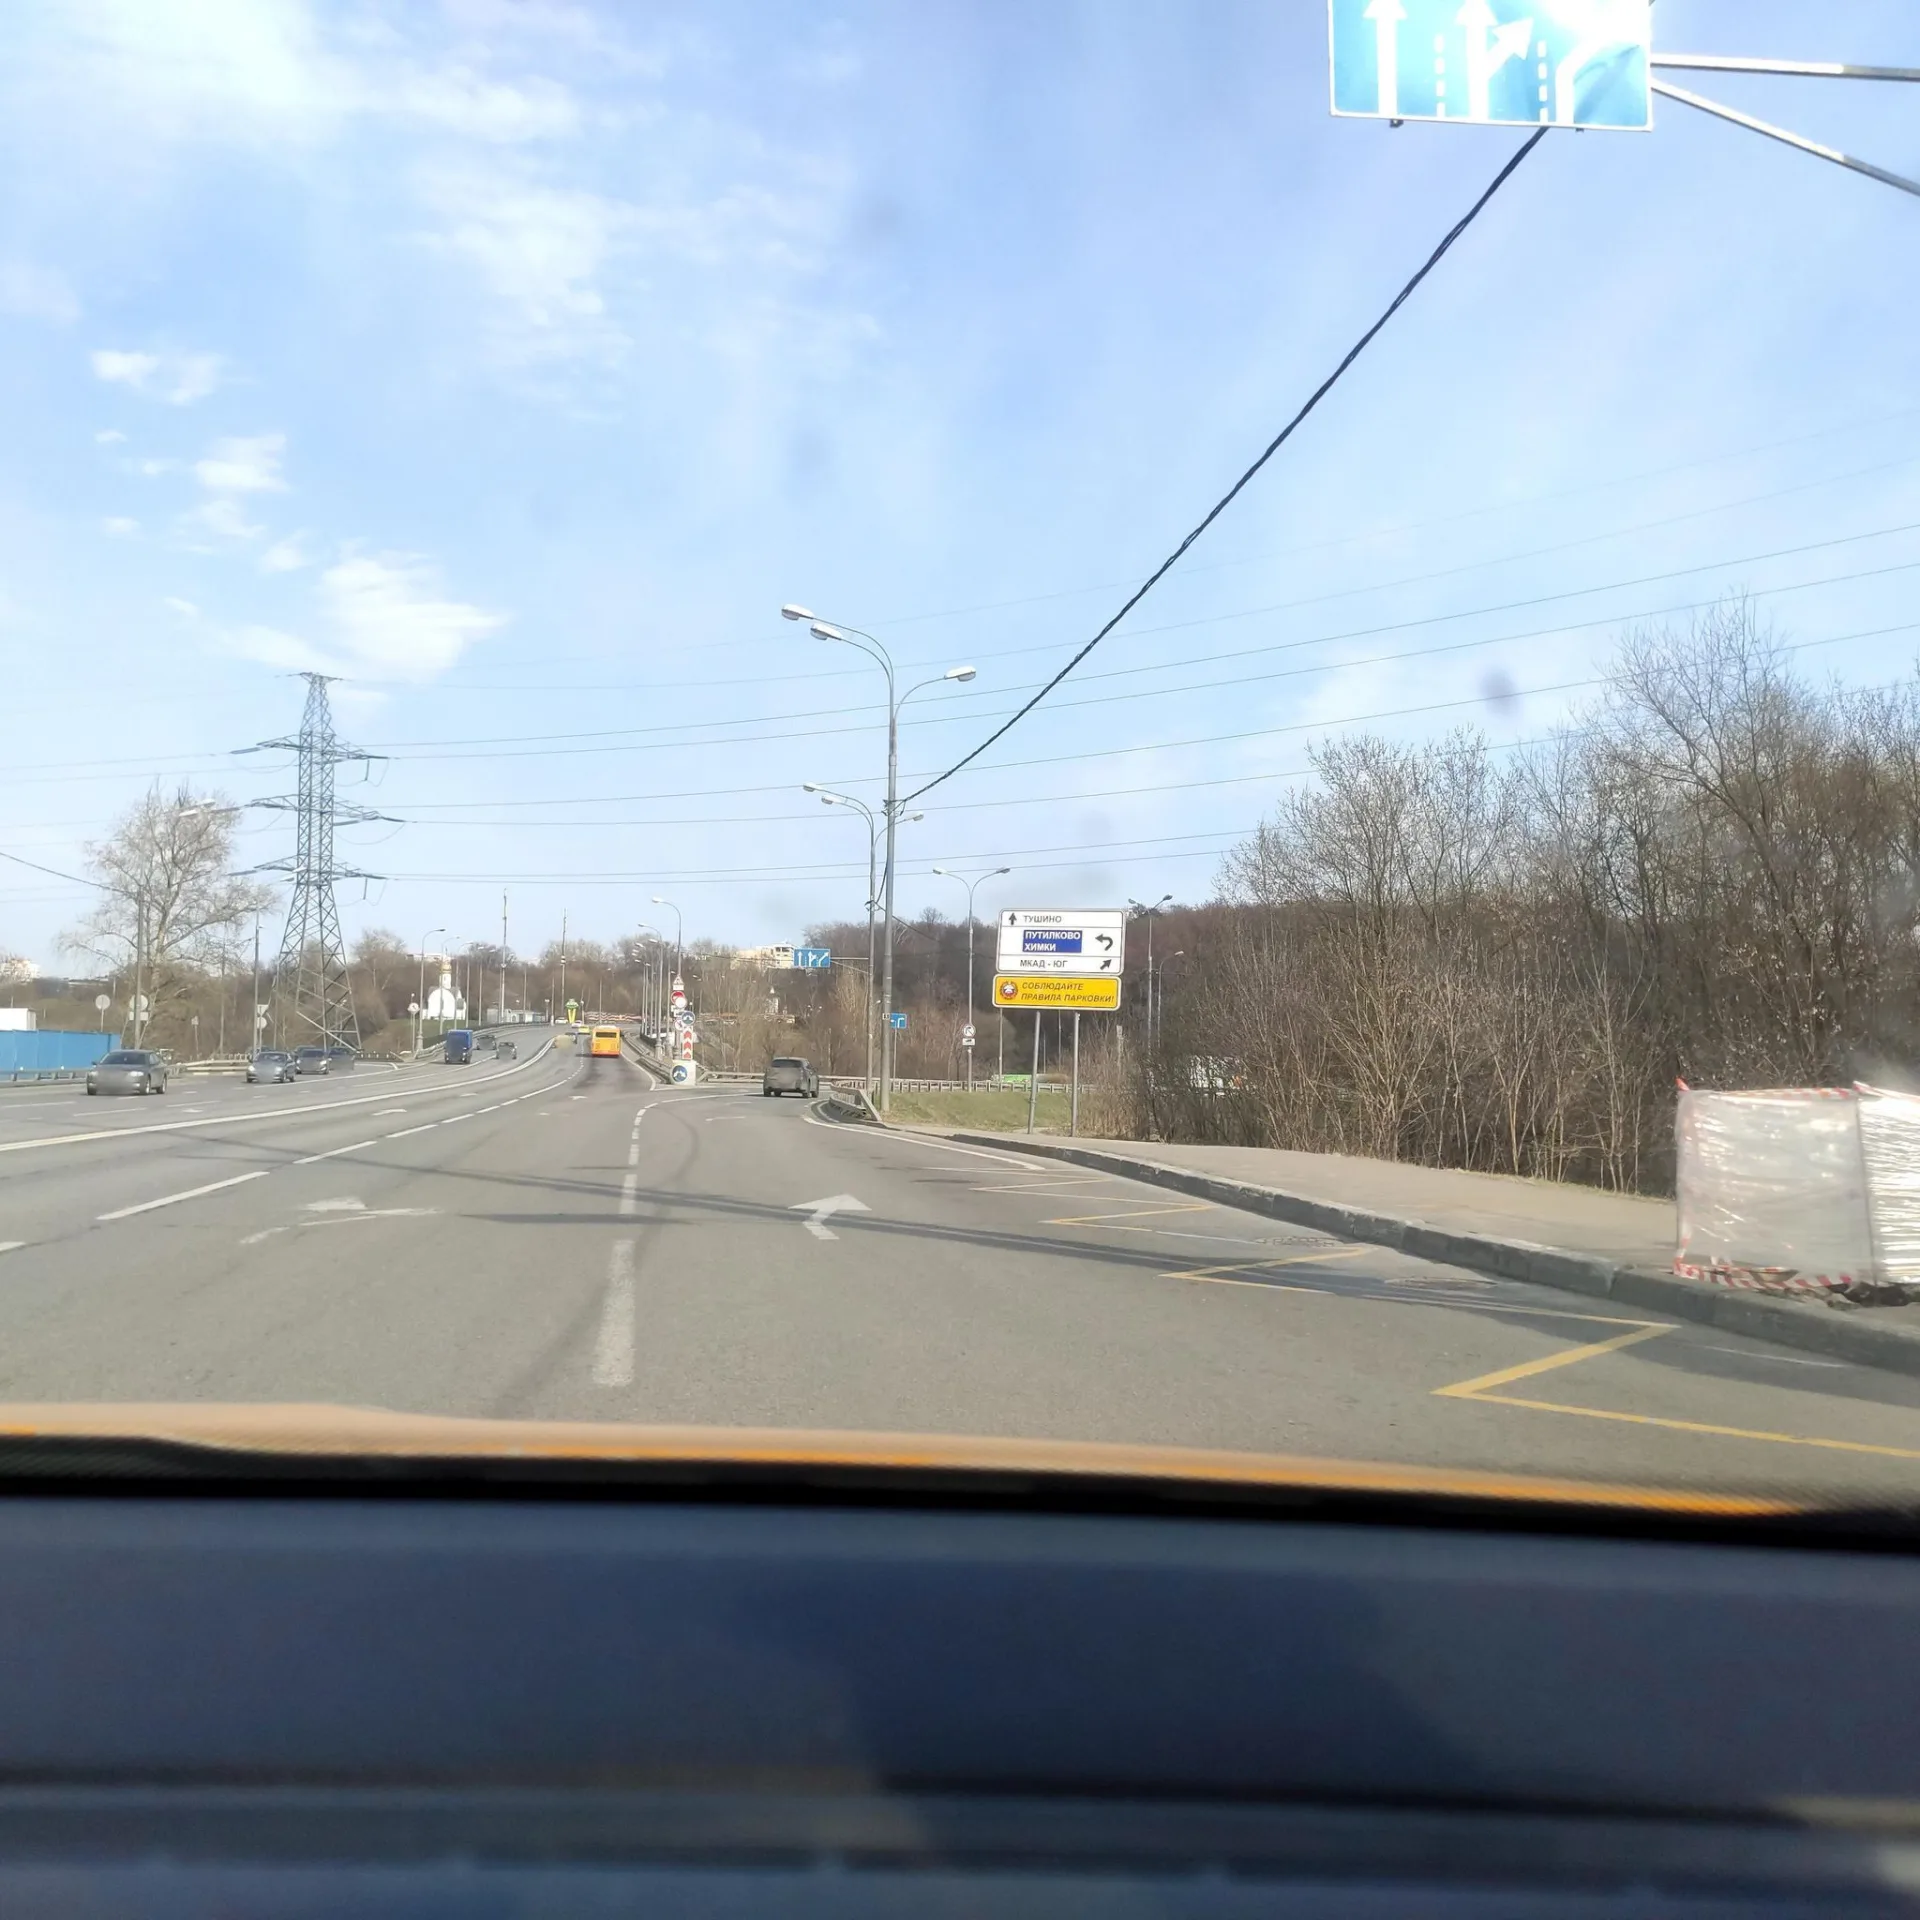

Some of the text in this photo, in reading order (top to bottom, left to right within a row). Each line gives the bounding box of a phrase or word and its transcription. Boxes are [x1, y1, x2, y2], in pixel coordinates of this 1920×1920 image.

[1023, 915, 1062, 923] ТУШИНО
[1025, 931, 1081, 940] ПУТИЛКОВО
[1024, 942, 1056, 951] ХИМКИ
[1020, 959, 1045, 968] МКАД
[1053, 960, 1068, 968] ЮГ
[1022, 981, 1084, 990] СОБЛЮДАЙТЕ
[1021, 993, 1114, 1002] ПРАВИЛА ПАРКОВКИ!
